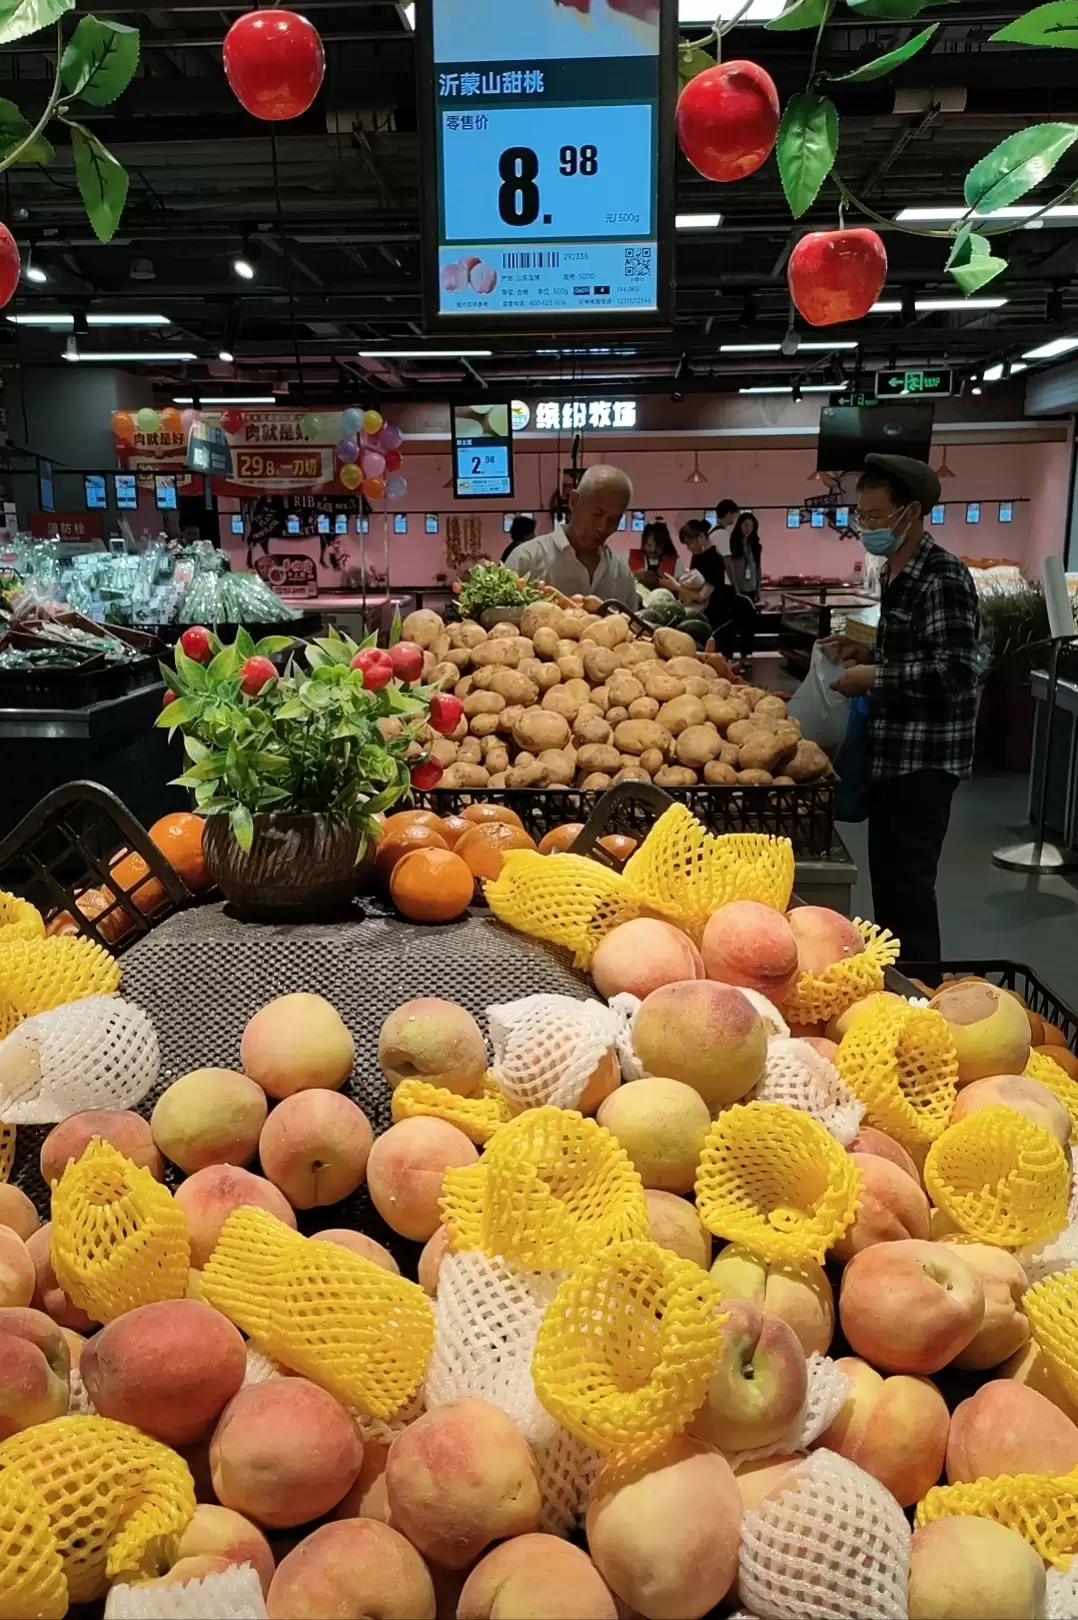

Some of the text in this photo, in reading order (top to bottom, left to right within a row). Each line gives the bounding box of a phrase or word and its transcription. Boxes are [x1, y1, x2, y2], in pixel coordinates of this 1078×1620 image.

[438, 69, 545, 97] 沂蒙山甜桃
[446, 114, 489, 131] 零售价
[558, 144, 599, 177] 98
[536, 400, 637, 429] 缤纷牧场
